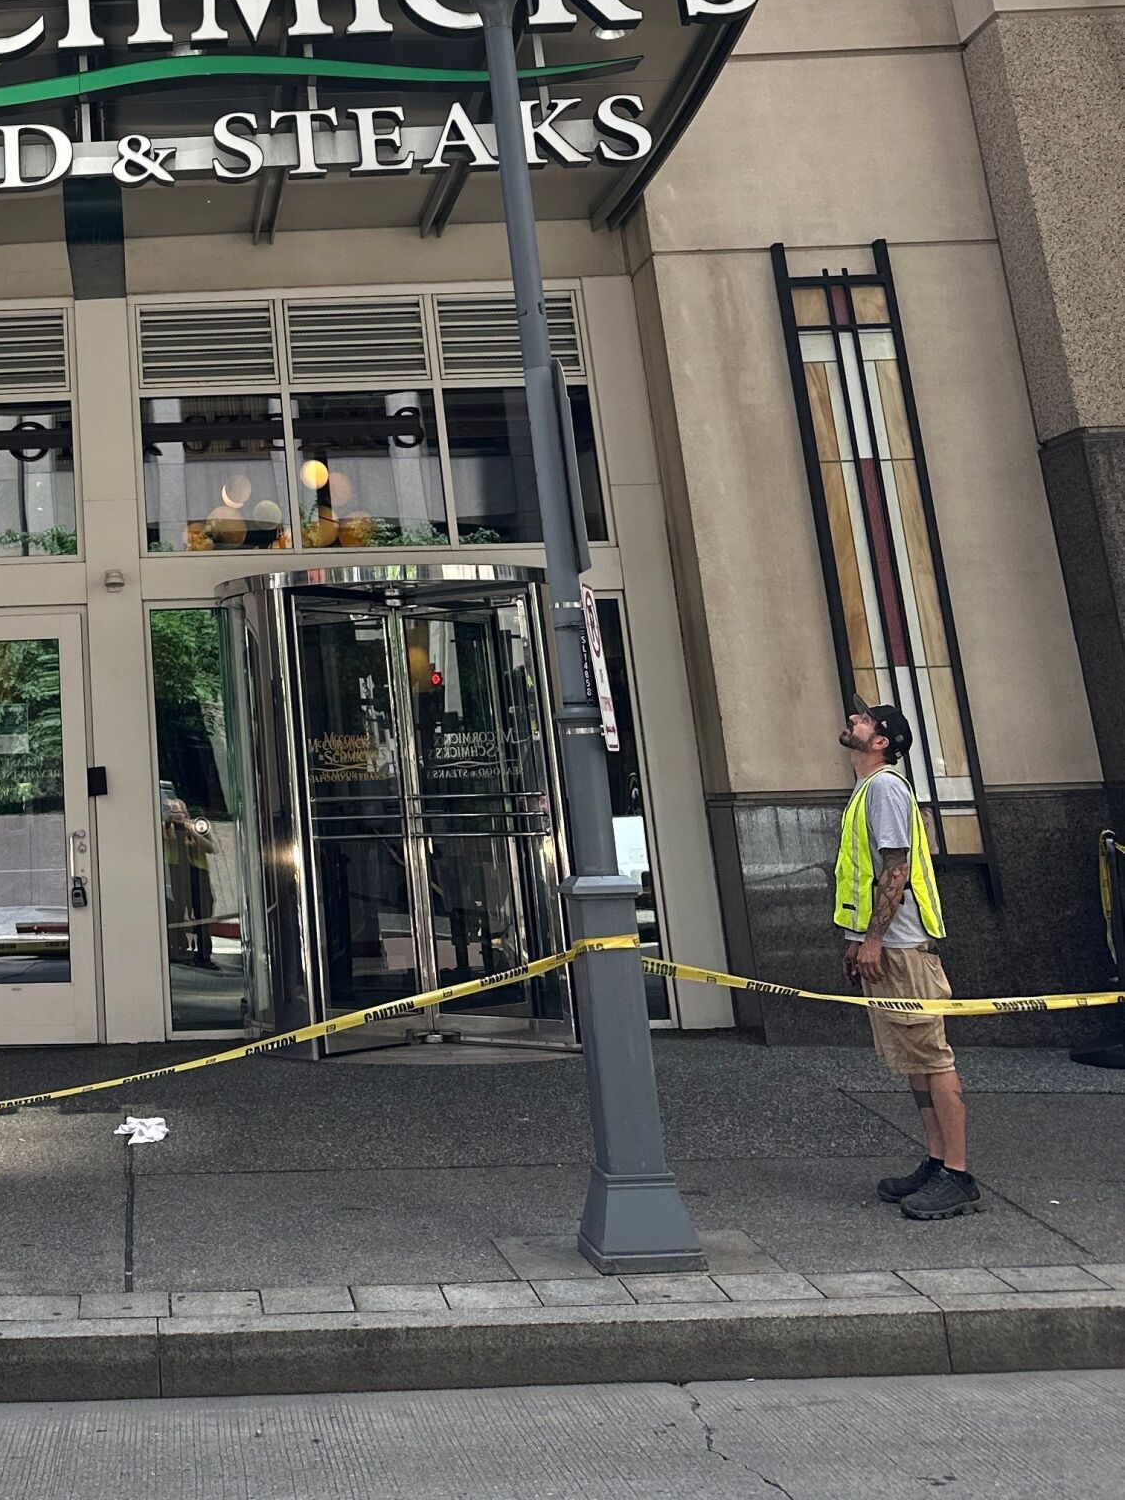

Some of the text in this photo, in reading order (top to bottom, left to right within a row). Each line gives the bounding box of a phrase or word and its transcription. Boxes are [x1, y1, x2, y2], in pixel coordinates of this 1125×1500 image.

[113, 132, 177, 186] &
[211, 93, 655, 184] STEAKS
[363, 1000, 414, 1023] CAUTION
[867, 999, 924, 1011] CAUTION
[245, 1034, 297, 1057] CAUTION
